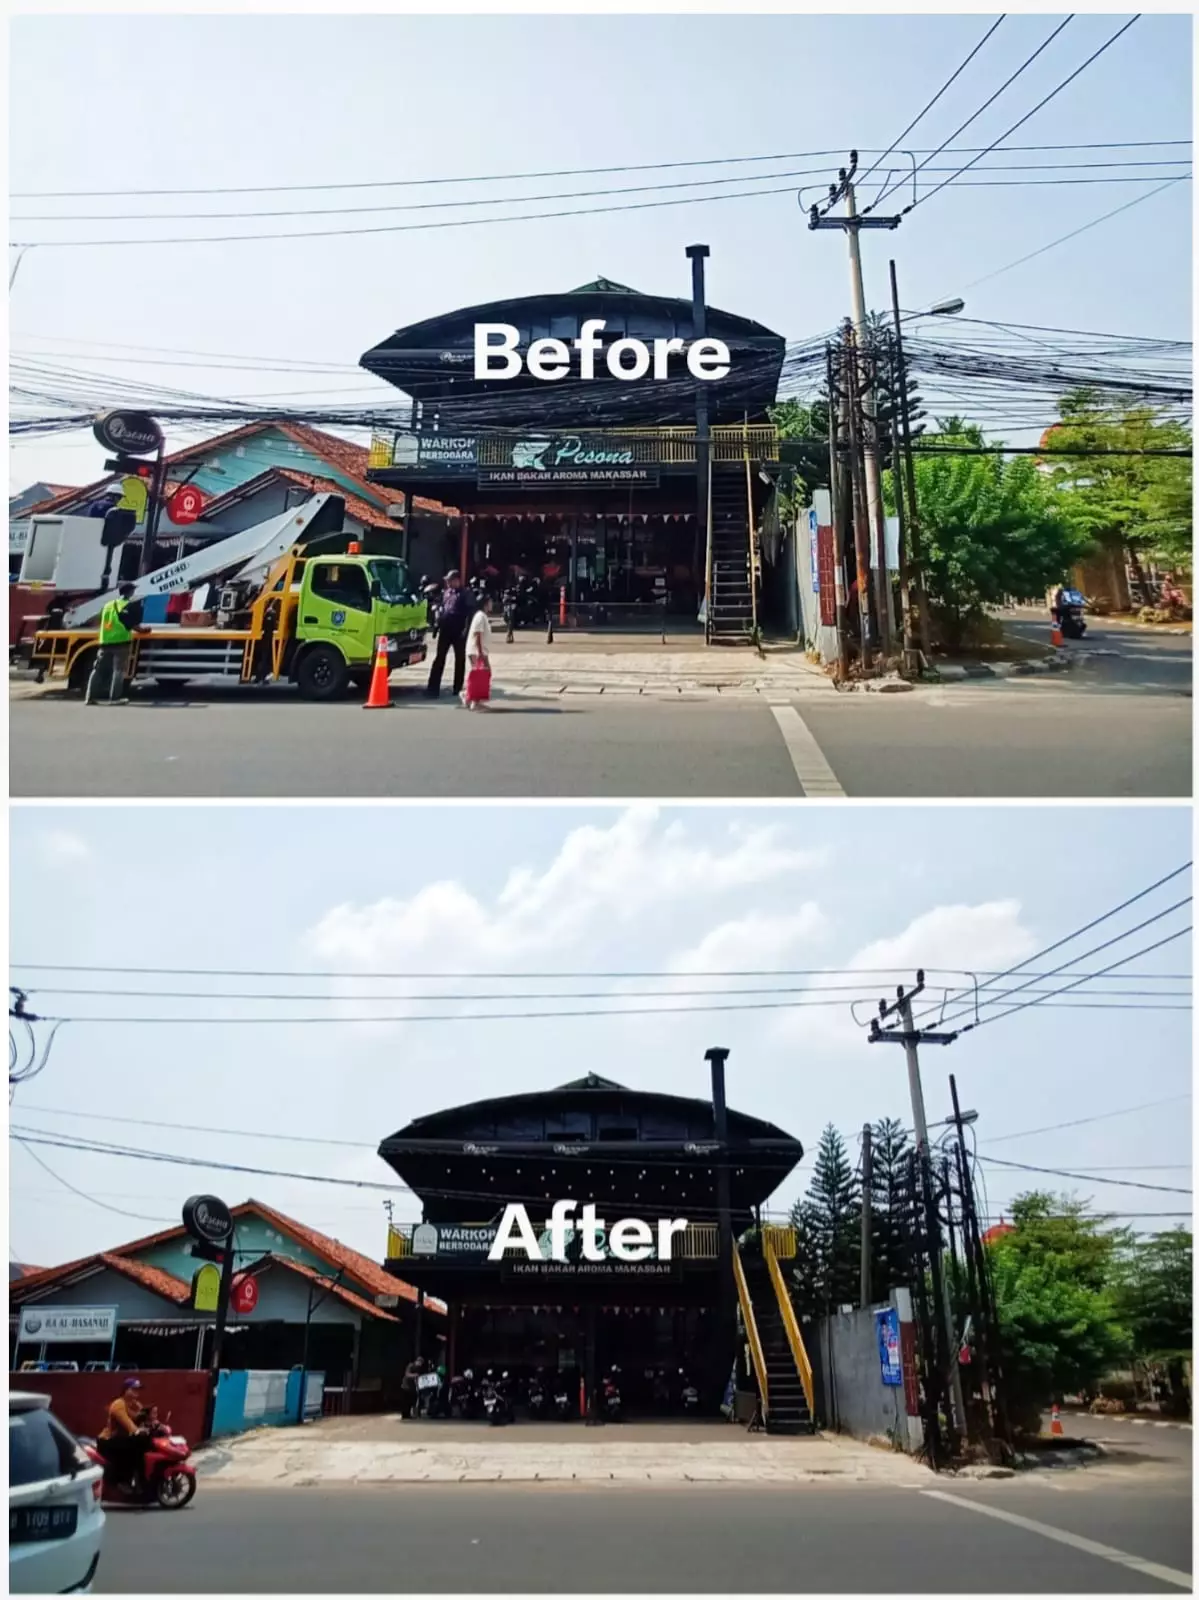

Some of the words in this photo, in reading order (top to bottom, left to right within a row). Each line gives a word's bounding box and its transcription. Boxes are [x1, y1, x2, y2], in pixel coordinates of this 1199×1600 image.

[555, 436, 635, 466] Pesona
[489, 471, 516, 481] IKAN
[552, 470, 589, 481] AROMA
[589, 469, 648, 480] MAKASSAR
[440, 1228, 496, 1241] WARKOP
[513, 1265, 539, 1274] IKAN
[576, 1265, 613, 1274] AROMA
[614, 1265, 671, 1274] MAKASSAR
